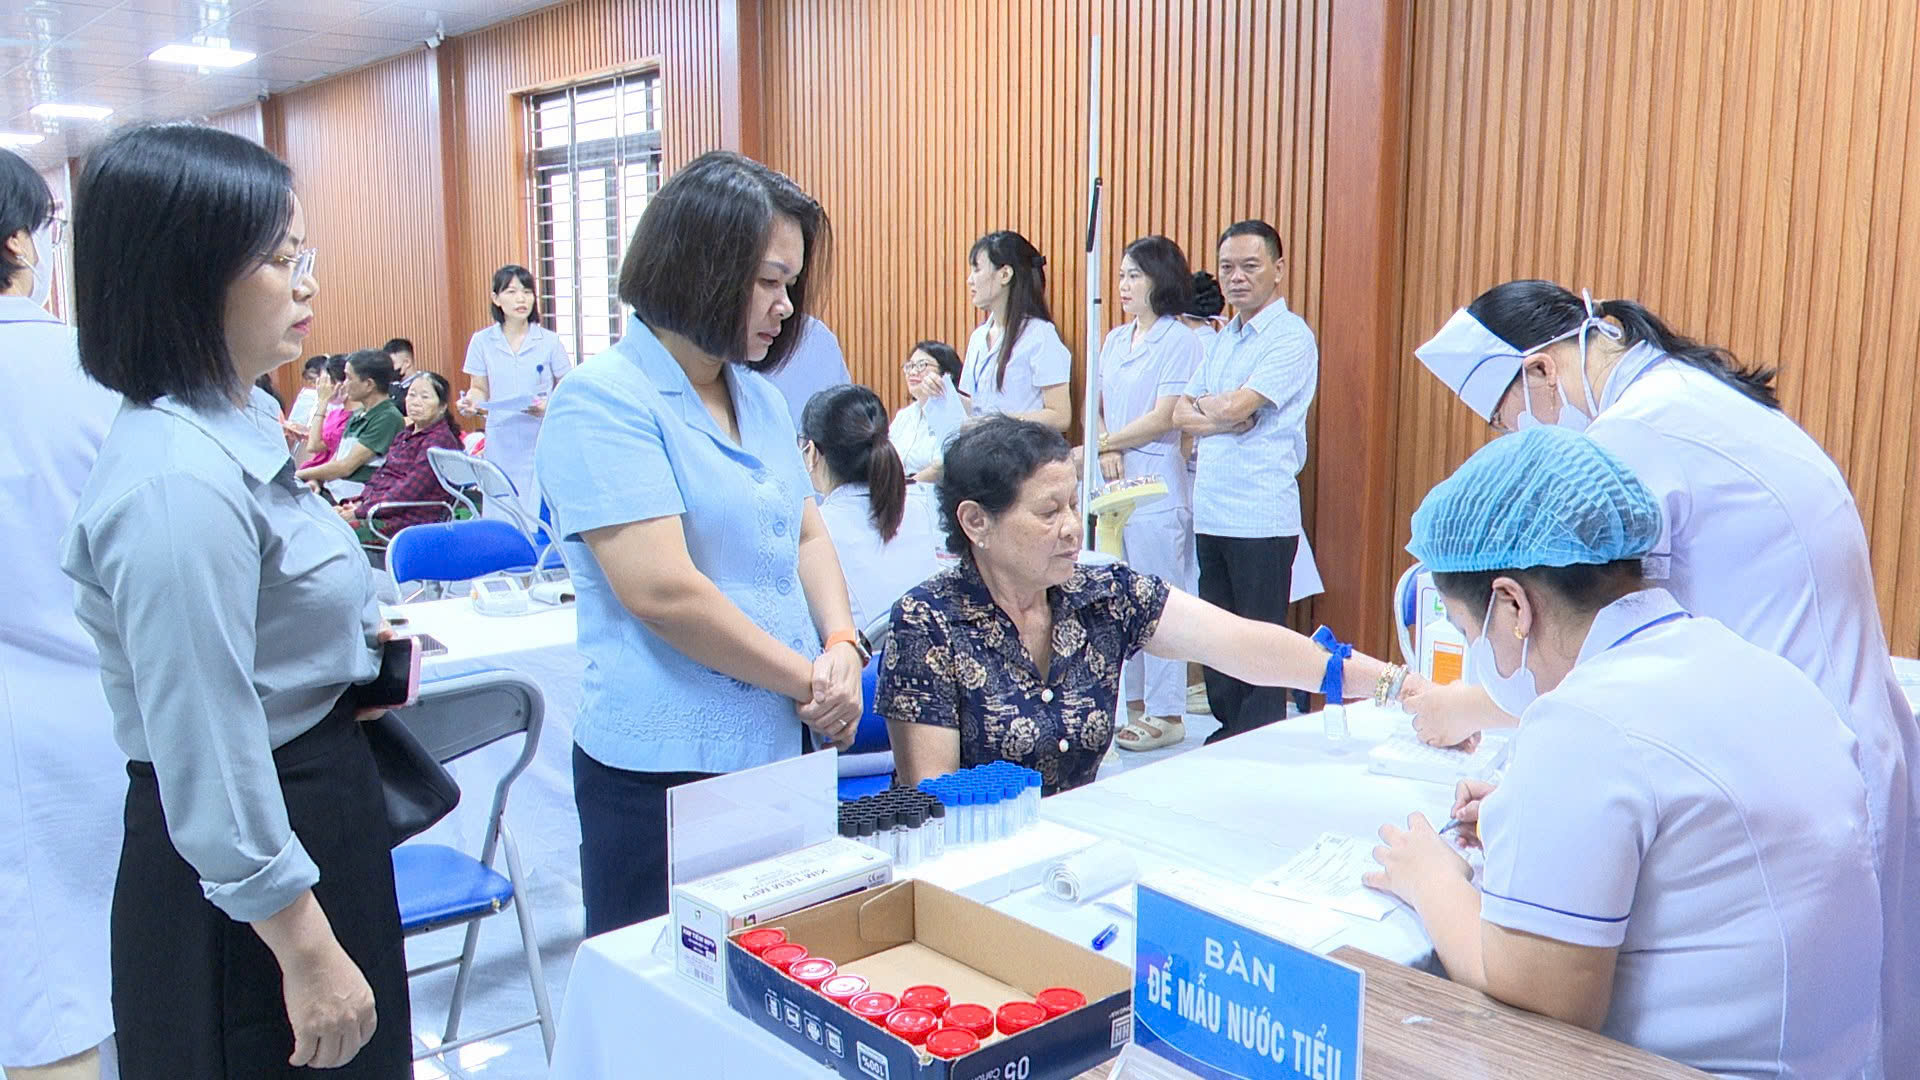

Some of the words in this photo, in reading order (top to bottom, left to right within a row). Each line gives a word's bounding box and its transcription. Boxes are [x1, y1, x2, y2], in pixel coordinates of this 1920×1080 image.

[1205, 936, 1275, 993] BÀN
[1147, 954, 1173, 1011] ĐỂ
[1177, 971, 1221, 1033] MẪU
[1227, 999, 1285, 1064] NƯỚC
[1292, 1023, 1342, 1080] TIỂU
[861, 1055, 885, 1077] 100%
